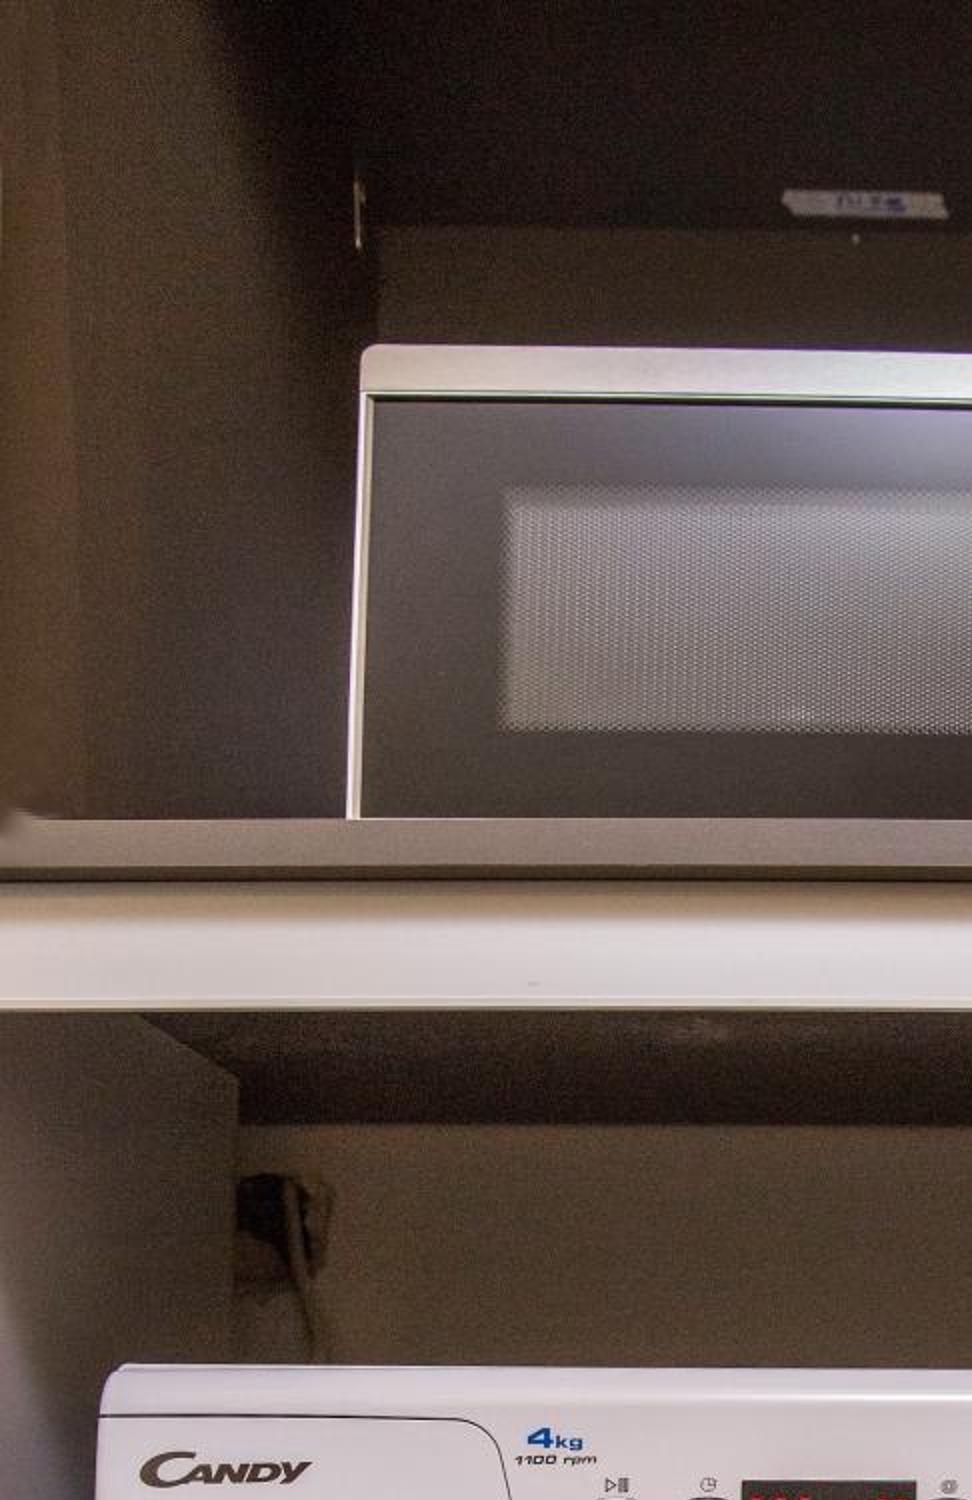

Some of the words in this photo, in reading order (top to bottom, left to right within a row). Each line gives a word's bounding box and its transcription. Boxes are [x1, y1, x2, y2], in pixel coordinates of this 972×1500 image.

[139, 1450, 313, 1489] CANDY
[515, 1454, 557, 1465] 1100
[563, 1455, 597, 1466] rpm
